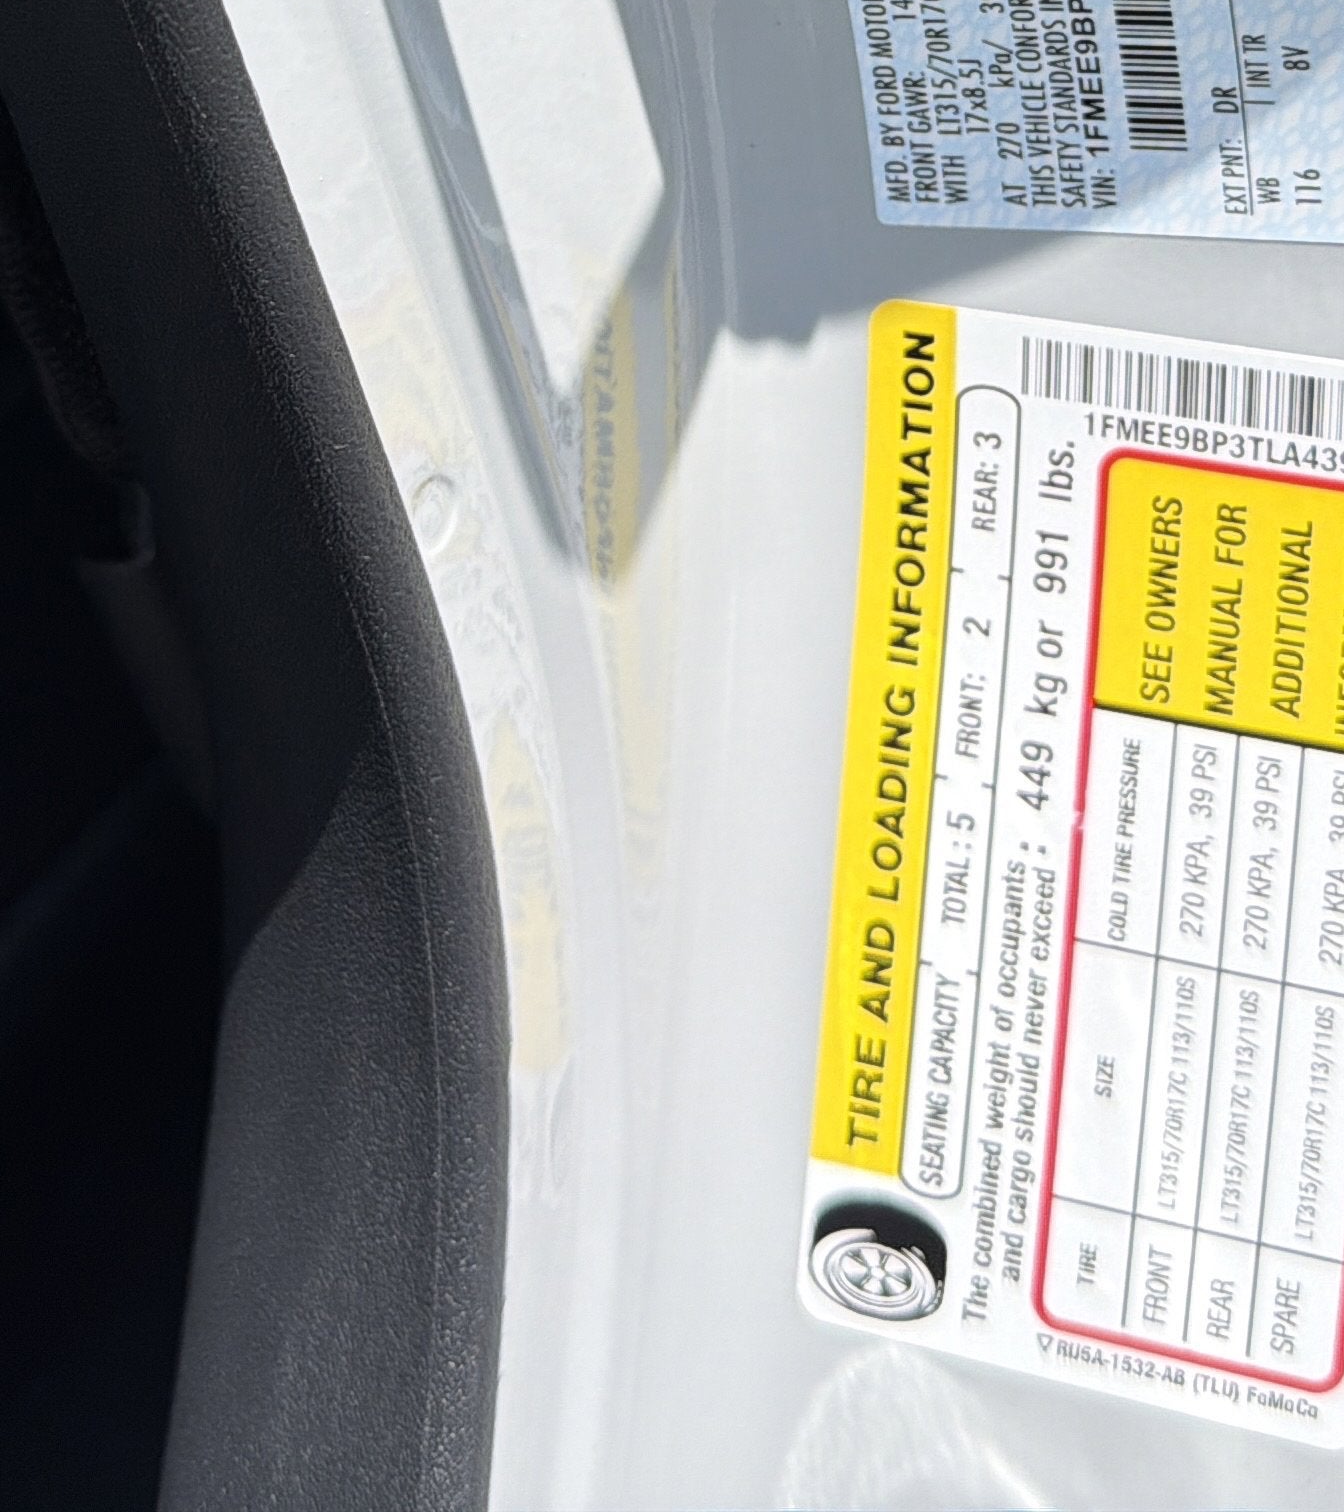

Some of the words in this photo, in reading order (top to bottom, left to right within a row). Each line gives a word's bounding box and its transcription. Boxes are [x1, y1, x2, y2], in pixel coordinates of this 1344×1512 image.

[981, 38, 1016, 89] kPa/
[1240, 33, 1268, 55] TR
[1243, 58, 1272, 89] INT
[1280, 44, 1312, 72] 8V
[871, 64, 902, 117] FORD
[901, 70, 933, 135] GAWR:
[956, 58, 992, 135] 17x8.5J
[1040, 18, 1081, 135] STANDARDS
[1210, 85, 1241, 115] DR
[878, 122, 906, 148] BY
[994, 121, 1025, 161] 270
[1018, 80, 1053, 159] VEHICLE
[883, 153, 912, 204] MFD.
[908, 139, 941, 204] FRONT
[940, 154, 970, 205] WITH
[1027, 164, 1058, 208] THIS
[1055, 139, 1088, 209] SAFETY
[1090, 168, 1119, 210] VIN:
[1217, 138, 1246, 179] PNT:
[1292, 167, 1323, 206] 116
[1000, 181, 1029, 208] AT
[1221, 182, 1249, 216] EXT
[1255, 176, 1282, 205] WB
[971, 430, 1003, 451] 3
[1037, 440, 1076, 503] lbs.
[887, 330, 936, 667] INFORMATION
[970, 461, 1000, 533] REAR:
[1032, 529, 1070, 595] 991
[1144, 495, 1184, 633] OWNERS
[1213, 502, 1248, 568] FOR
[961, 616, 992, 639] 2
[1036, 618, 1065, 660] or
[1203, 578, 1244, 717] MANUAL
[1269, 520, 1314, 720] ADDITIONAL
[1022, 671, 1069, 718] kg
[1138, 641, 1174, 705] SEE
[953, 672, 987, 760] FRONT:
[1015, 739, 1055, 813] 449
[1115, 737, 1142, 839] PRESSURE
[1190, 742, 1219, 783] PSI
[1254, 754, 1283, 795] PSI
[867, 686, 917, 903] LOADING
[945, 810, 977, 833] 5
[1187, 786, 1215, 820] 39
[1251, 799, 1280, 832] 39
[939, 856, 971, 925] TOTAL
[1111, 842, 1133, 884] TIRE
[1182, 834, 1215, 887] KPA,
[1246, 846, 1280, 901] KPA,
[996, 859, 1028, 999] occupants
[1029, 866, 1057, 963] exceed
[1106, 890, 1130, 943] COLD
[1178, 891, 1207, 939] 270
[1241, 904, 1271, 952] 270
[858, 920, 896, 1025] AND
[926, 972, 961, 1087] CAPACITY
[989, 1004, 1015, 1033] of
[1022, 968, 1048, 1047] never
[1170, 975, 1198, 1065] 113/110S
[1233, 988, 1261, 1080] 113/110S
[1093, 1054, 1116, 1100] SIZE
[1307, 1004, 1336, 1096] 113/110S
[845, 1035, 887, 1148] TIRE
[984, 1041, 1015, 1131] weight
[1010, 1051, 1041, 1144] should
[918, 1090, 951, 1189] SEATING
[1156, 1069, 1190, 1211] LT315/70R17C
[1219, 1083, 1253, 1226] LT315/70R17C
[1293, 1099, 1327, 1243] LT315/70R17C
[972, 1138, 1003, 1269] combined
[1006, 1149, 1037, 1226] cargo
[999, 1230, 1025, 1284] and
[1075, 1242, 1098, 1286] TIRE
[1141, 1243, 1173, 1327] FRONT
[960, 1273, 991, 1322] The
[1204, 1277, 1236, 1341] REAR
[1268, 1276, 1302, 1357] SPARE
[1191, 1372, 1241, 1404] (TLU)
